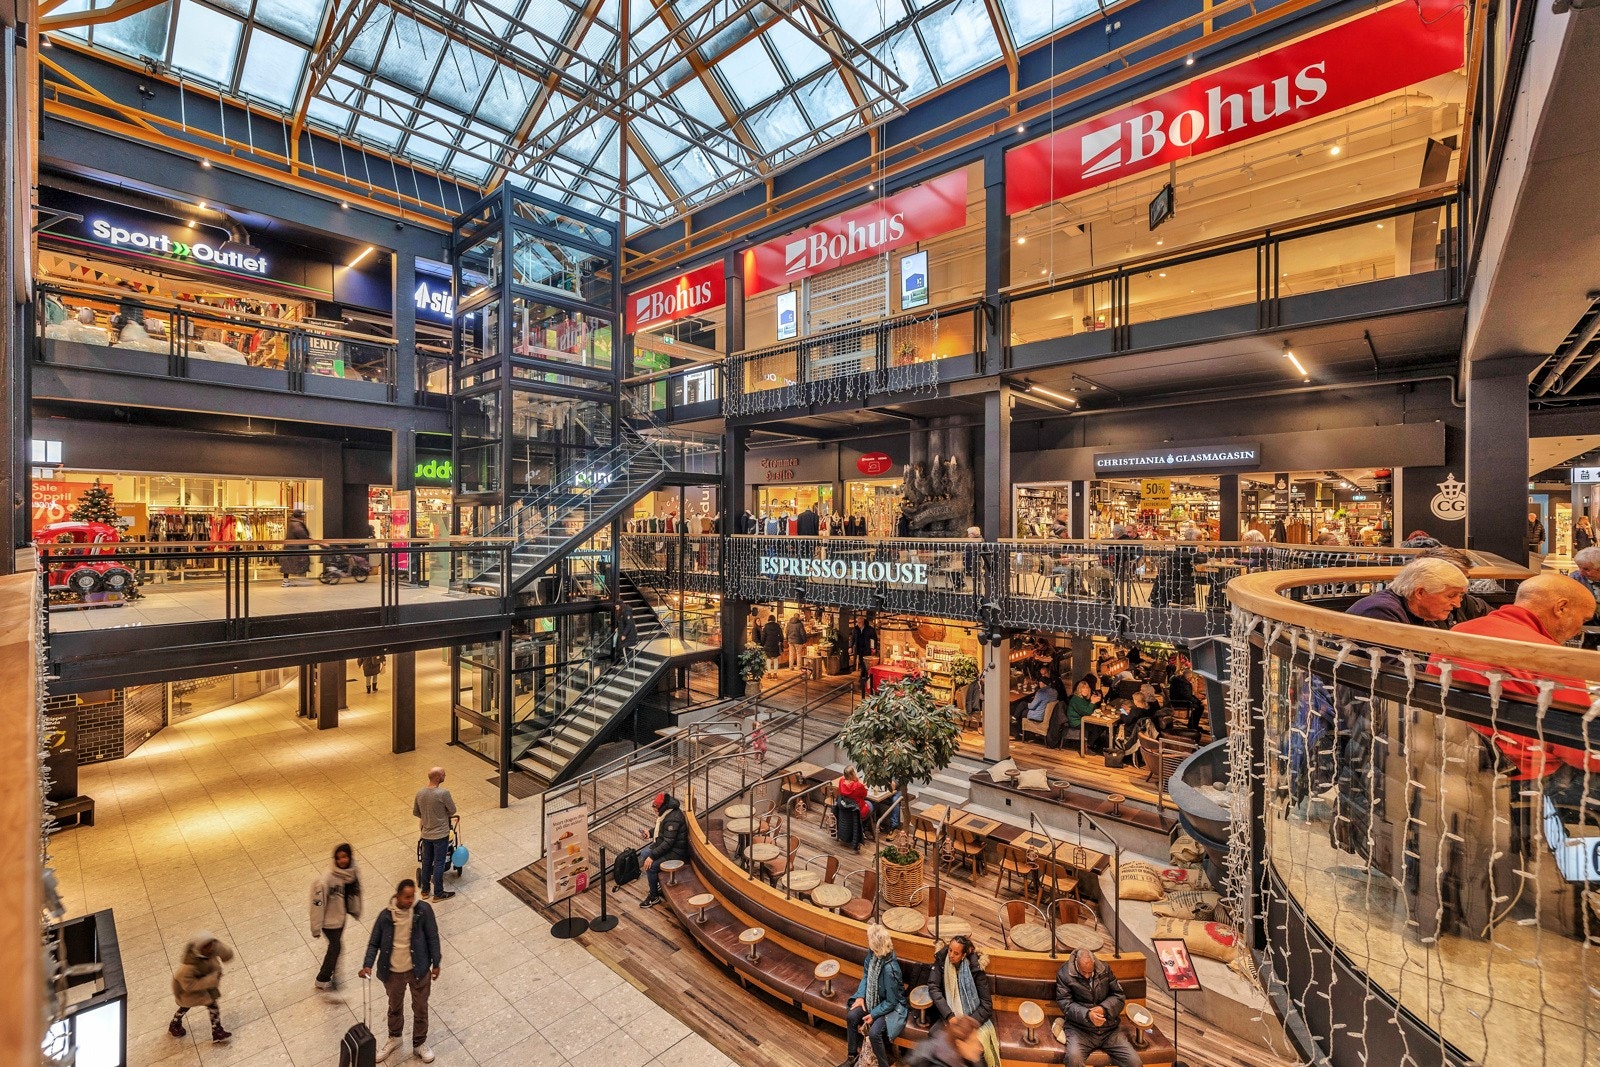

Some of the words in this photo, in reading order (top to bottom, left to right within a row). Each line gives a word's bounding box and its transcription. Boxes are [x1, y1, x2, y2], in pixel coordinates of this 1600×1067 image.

[1125, 61, 1328, 165] Bohus
[93, 219, 171, 253] Sport
[192, 243, 268, 274] Outlet
[808, 211, 905, 267] Bohus
[650, 280, 712, 320] Bohus
[1097, 457, 1165, 467] CHRISTIANIA
[1175, 451, 1255, 463] GLASMAGASIN
[32, 483, 57, 491] Sale
[32, 492, 72, 501] Opptil
[1145, 483, 1166, 495] 50%
[1437, 500, 1466, 512] CG
[760, 556, 847, 580] ESPRESSO
[851, 560, 928, 585] HOUSE
